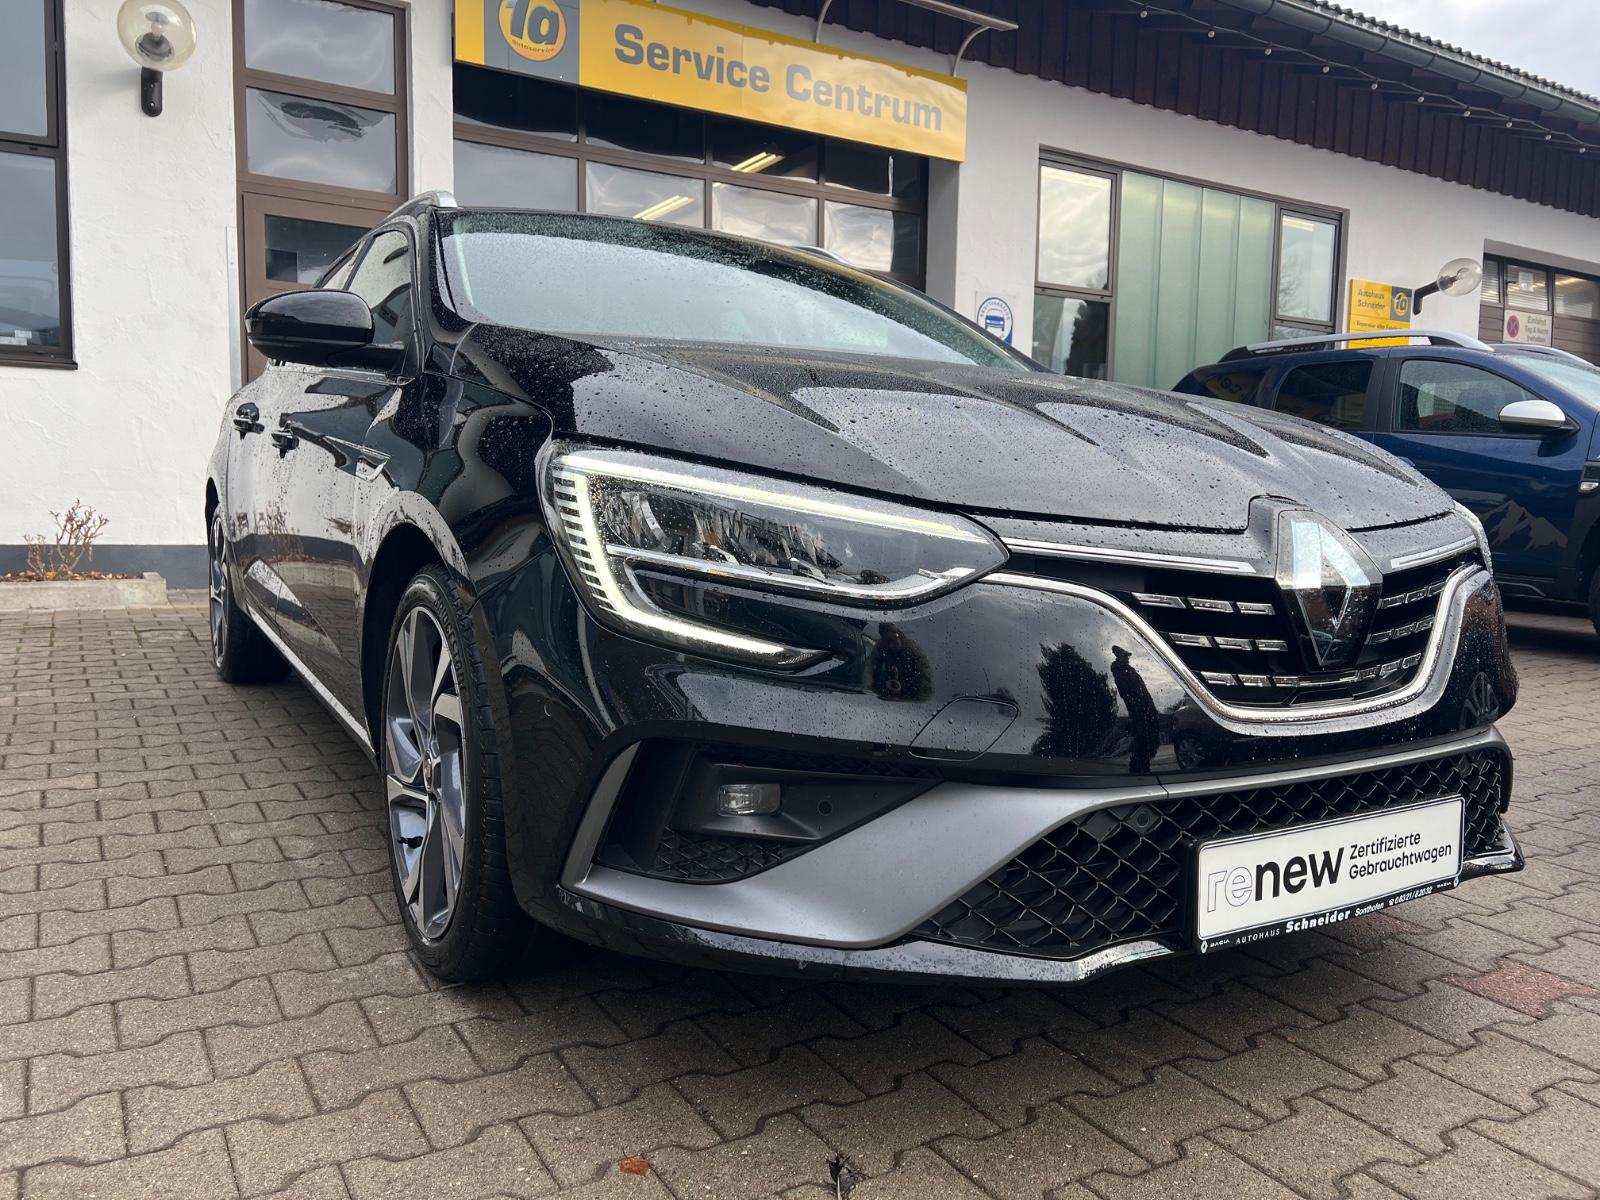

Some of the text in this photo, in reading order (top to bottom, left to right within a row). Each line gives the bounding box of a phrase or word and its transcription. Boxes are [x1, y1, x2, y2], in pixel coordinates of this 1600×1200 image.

[511, 39, 556, 53] autoservice
[614, 24, 942, 131] Service Centrum
[1358, 288, 1385, 300] Autohaus
[1349, 832, 1421, 860] Zertifizierte
[1349, 843, 1452, 880] Gebrauchtwagen
[1207, 847, 1344, 912] renew
[1235, 928, 1280, 945] AUTOHAUS
[1285, 910, 1351, 934] Schneider
[1354, 901, 1385, 917] Sonthofen
